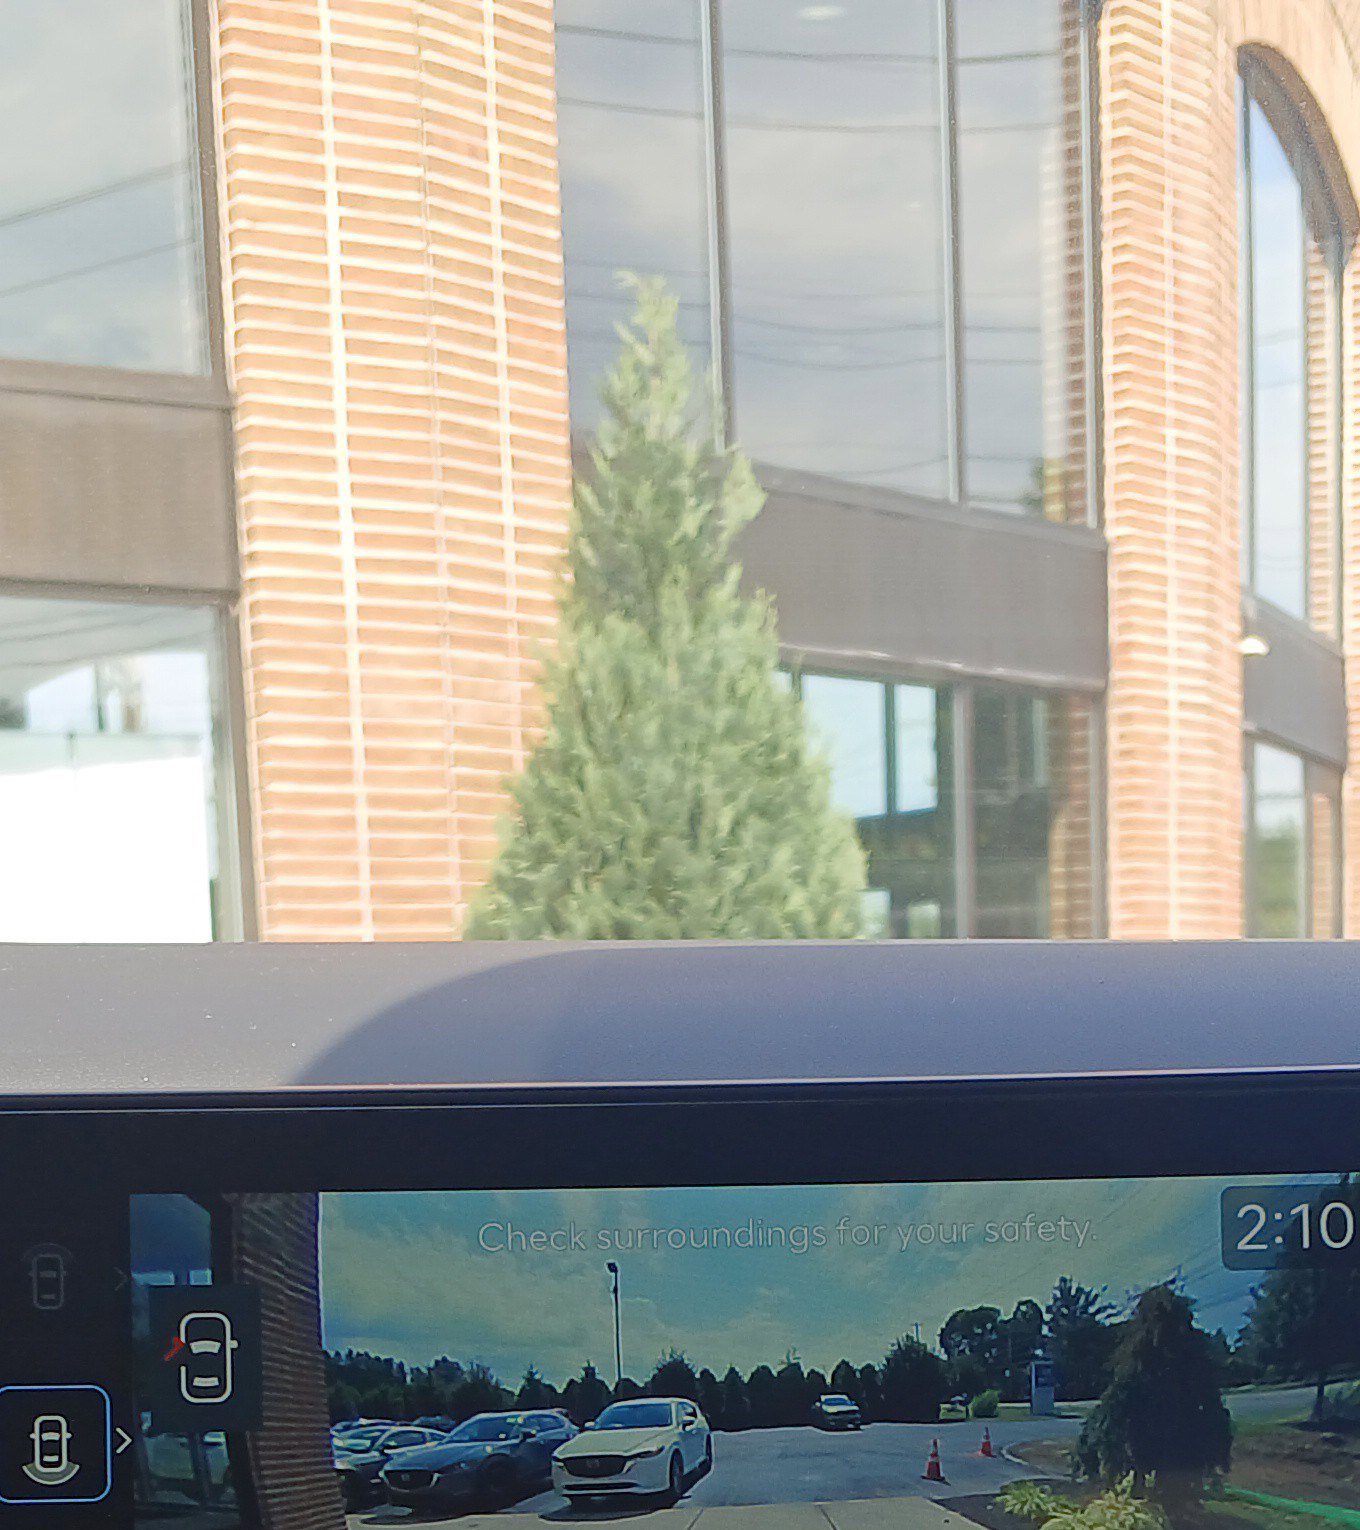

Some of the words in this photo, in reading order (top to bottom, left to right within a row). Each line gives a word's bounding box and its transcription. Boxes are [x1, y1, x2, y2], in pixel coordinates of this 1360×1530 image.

[478, 1222, 587, 1252] Check
[596, 1218, 828, 1254] surroundings
[836, 1216, 888, 1246] for
[896, 1221, 976, 1252] your
[984, 1213, 1099, 1248] safety.
[1236, 1202, 1355, 1250] 2:10
